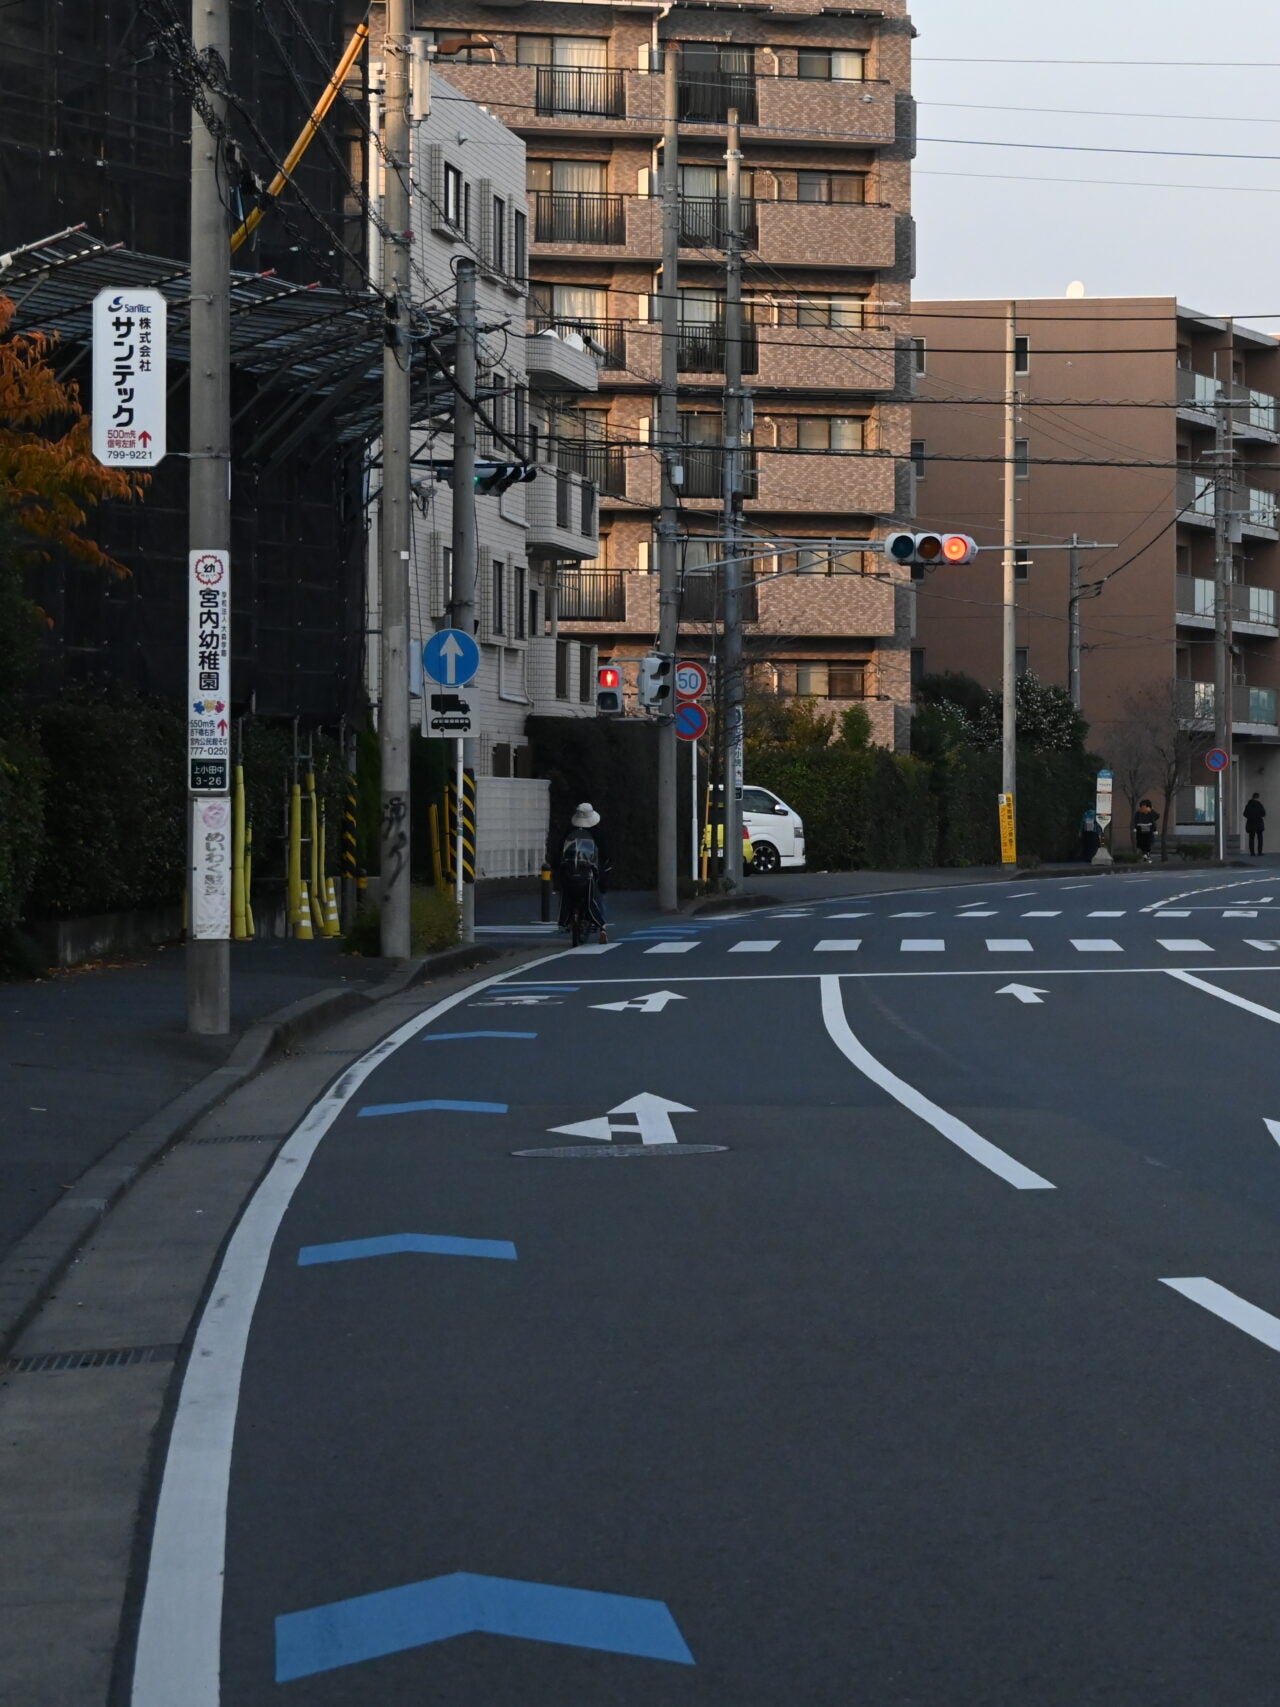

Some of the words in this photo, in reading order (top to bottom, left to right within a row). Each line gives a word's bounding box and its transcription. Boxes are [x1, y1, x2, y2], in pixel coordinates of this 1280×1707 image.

[139, 316, 152, 373] 株式会社
[112, 316, 136, 428] サンテック
[107, 430, 136, 439] 500m先
[107, 439, 136, 449] 信号左折
[107, 451, 153, 460] 799-9221
[198, 587, 220, 691] 宮内幼稚園
[678, 673, 699, 690] 50
[190, 747, 228, 755] 777-0250
[194, 766, 224, 774] 上小田中
[195, 777, 222, 785] 3-26
